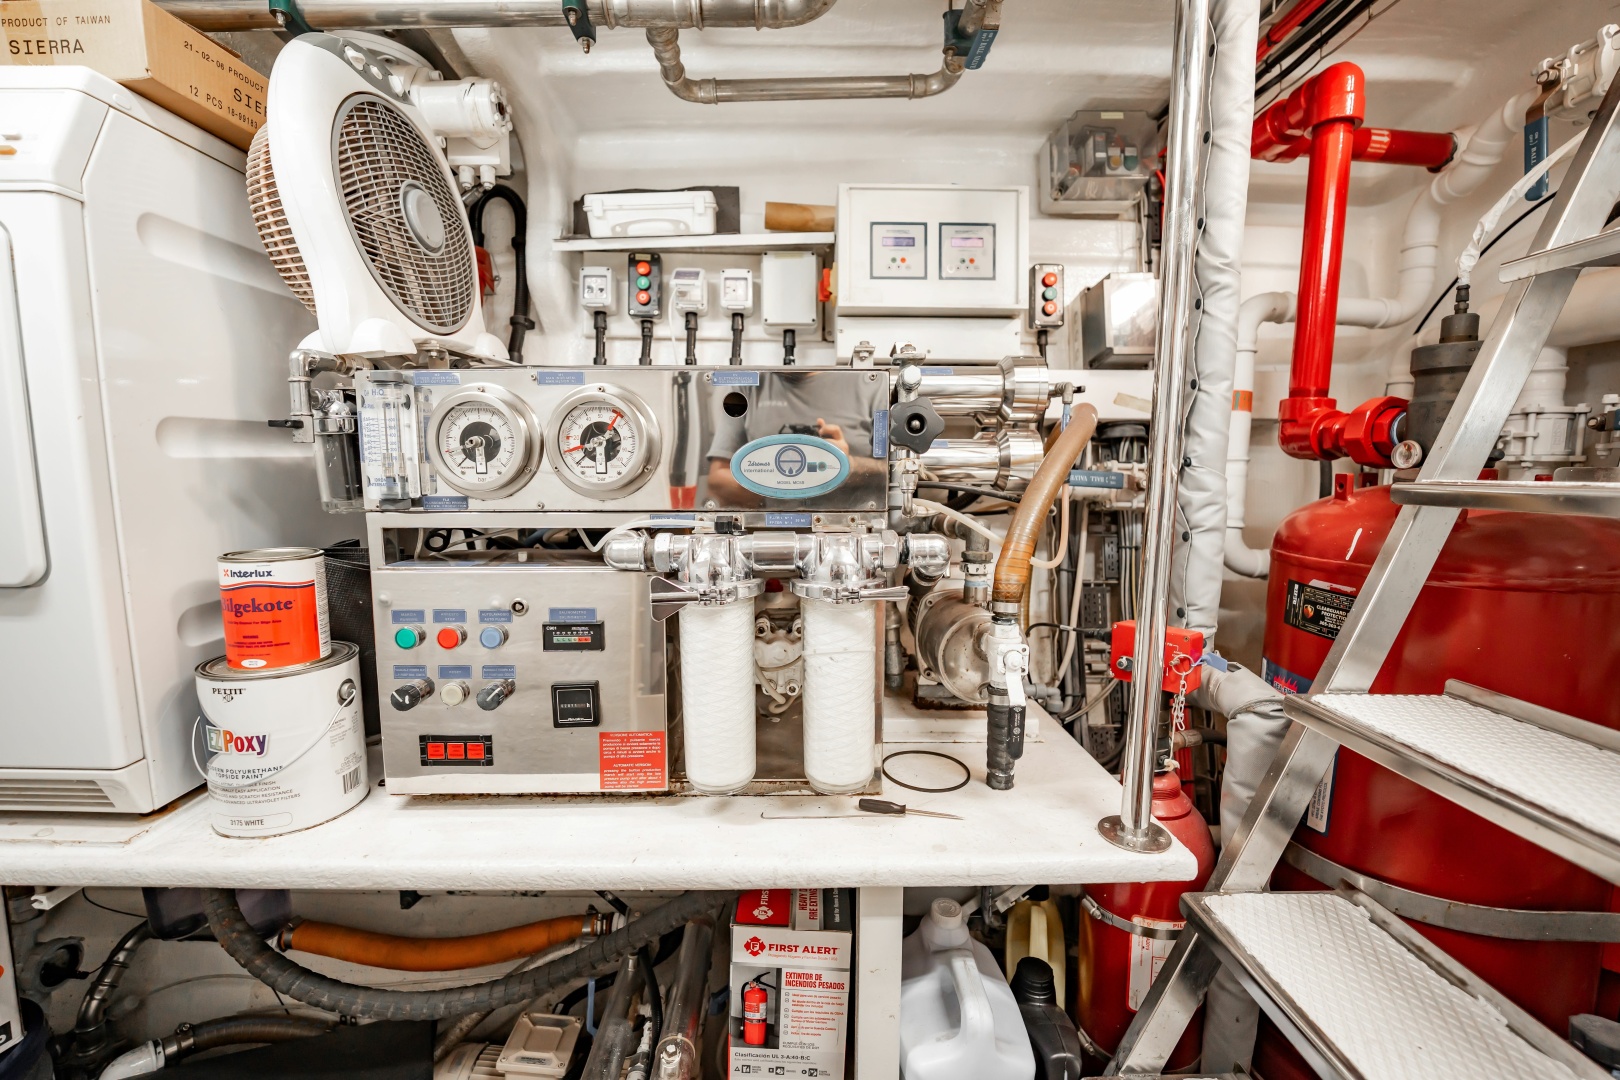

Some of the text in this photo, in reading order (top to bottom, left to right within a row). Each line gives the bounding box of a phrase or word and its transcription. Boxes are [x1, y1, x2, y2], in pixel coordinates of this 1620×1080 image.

[1, 15, 111, 28] PRODUCT OF TAIWAN
[9, 39, 85, 55] SIERRA
[184, 40, 264, 93] 21-02-06 PRODUCT
[189, 85, 258, 130] 12 PCS 18-99183
[233, 88, 268, 118] SIE
[230, 569, 273, 578] Interlux
[220, 598, 293, 618] Bilgekote
[1316, 605, 1346, 616] CLEARGUARD
[226, 765, 283, 774] POLYURETHANE
[262, 789, 293, 798] RESISTANCE
[799, 893, 807, 910] HEAVY
[809, 908, 818, 920] FIRE
[769, 944, 838, 955] FIRST ALERT
[785, 972, 813, 980] EXTINTOR
[785, 980, 816, 988] INCENDIOS
